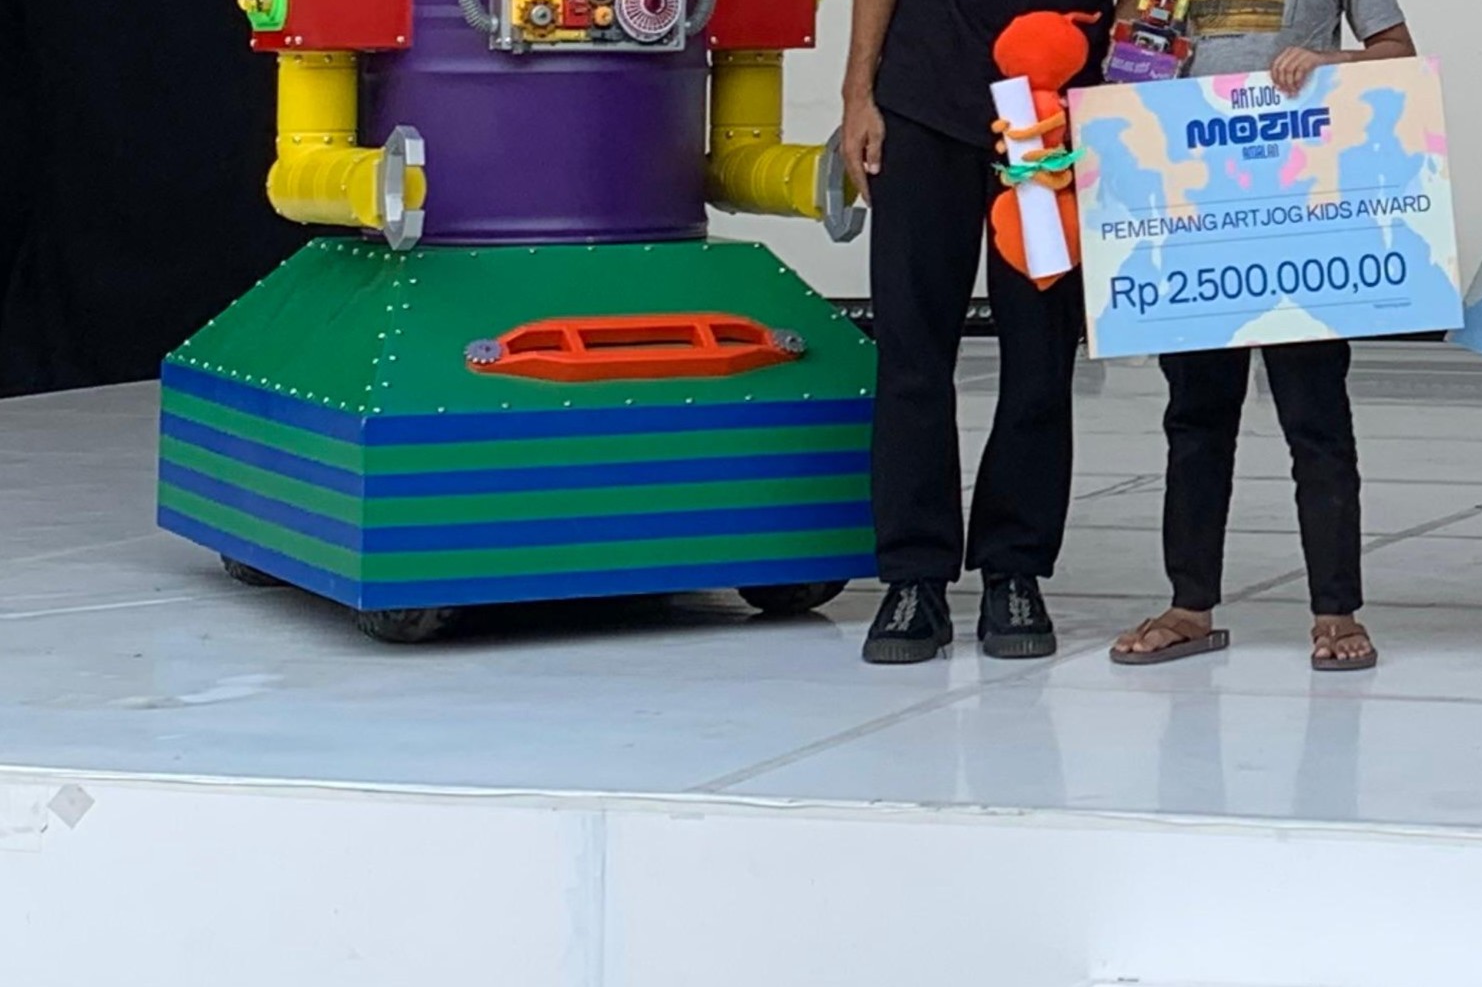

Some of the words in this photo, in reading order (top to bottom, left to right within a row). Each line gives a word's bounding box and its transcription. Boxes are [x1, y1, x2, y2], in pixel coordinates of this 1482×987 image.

[1230, 85, 1280, 109] ARTJOG
[1101, 213, 1218, 240] PEMENANG
[1221, 201, 1303, 228] ARTJOG
[1307, 196, 1353, 221] KIDS
[1357, 194, 1431, 218] AWARD
[1110, 276, 1160, 314] Rp
[1167, 251, 1407, 305] 2.500.000,00
